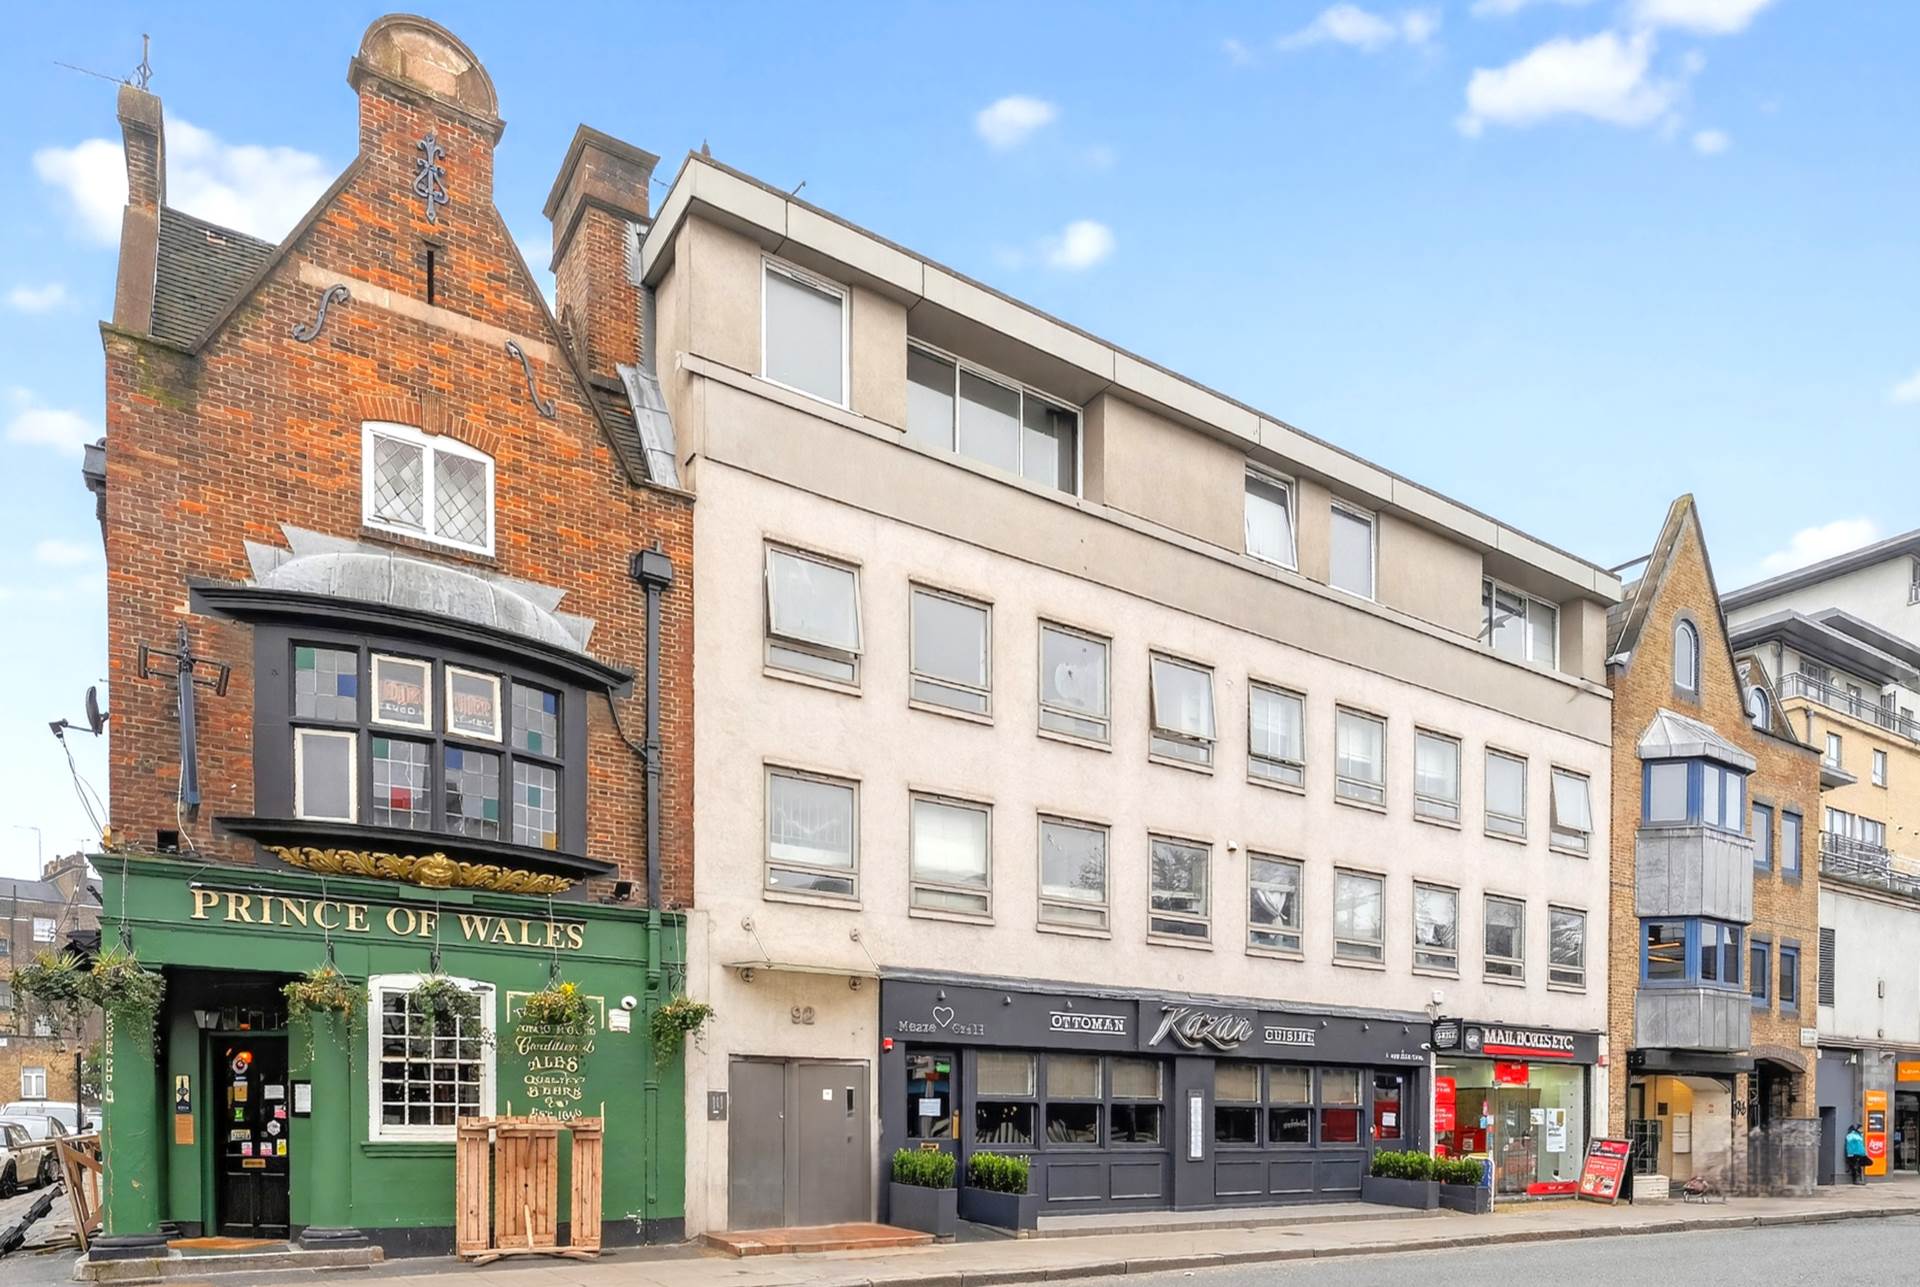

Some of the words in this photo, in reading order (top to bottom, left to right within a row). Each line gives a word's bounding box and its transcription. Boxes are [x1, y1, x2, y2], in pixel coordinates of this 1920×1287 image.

[190, 888, 371, 933] PRINCE
[385, 906, 440, 938] OF
[457, 913, 585, 950] WALES
[791, 1005, 816, 1025] 92
[1051, 1015, 1124, 1031] OTTOMAN
[1149, 1005, 1254, 1050] Kazan
[1264, 1029, 1315, 1043] CUISINE
[1483, 1028, 1515, 1045] MAIL
[528, 1056, 578, 1072] ALES
